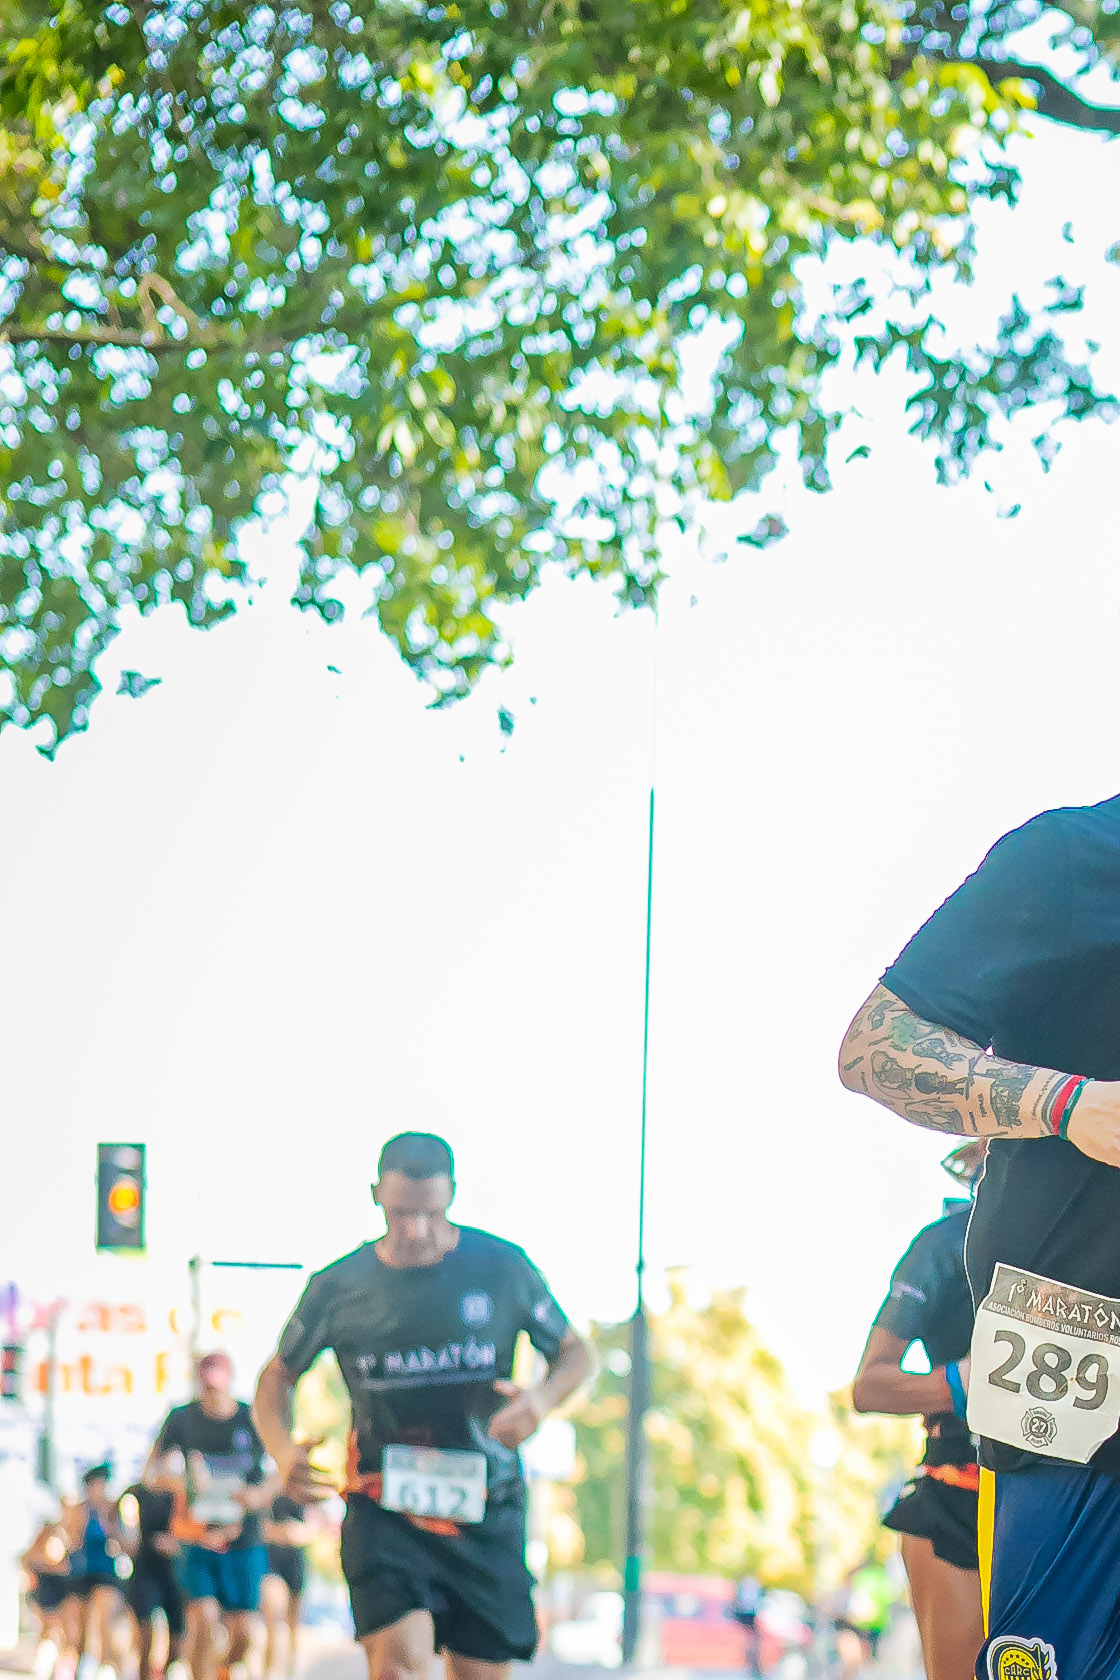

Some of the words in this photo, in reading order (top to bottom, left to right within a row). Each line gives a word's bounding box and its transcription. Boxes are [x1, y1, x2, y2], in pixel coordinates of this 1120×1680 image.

[1025, 1313, 1060, 1331] BOMBEROS
[1060, 1323, 1110, 1342] VOLUNTARIOS
[988, 1330, 1109, 1410] 289
